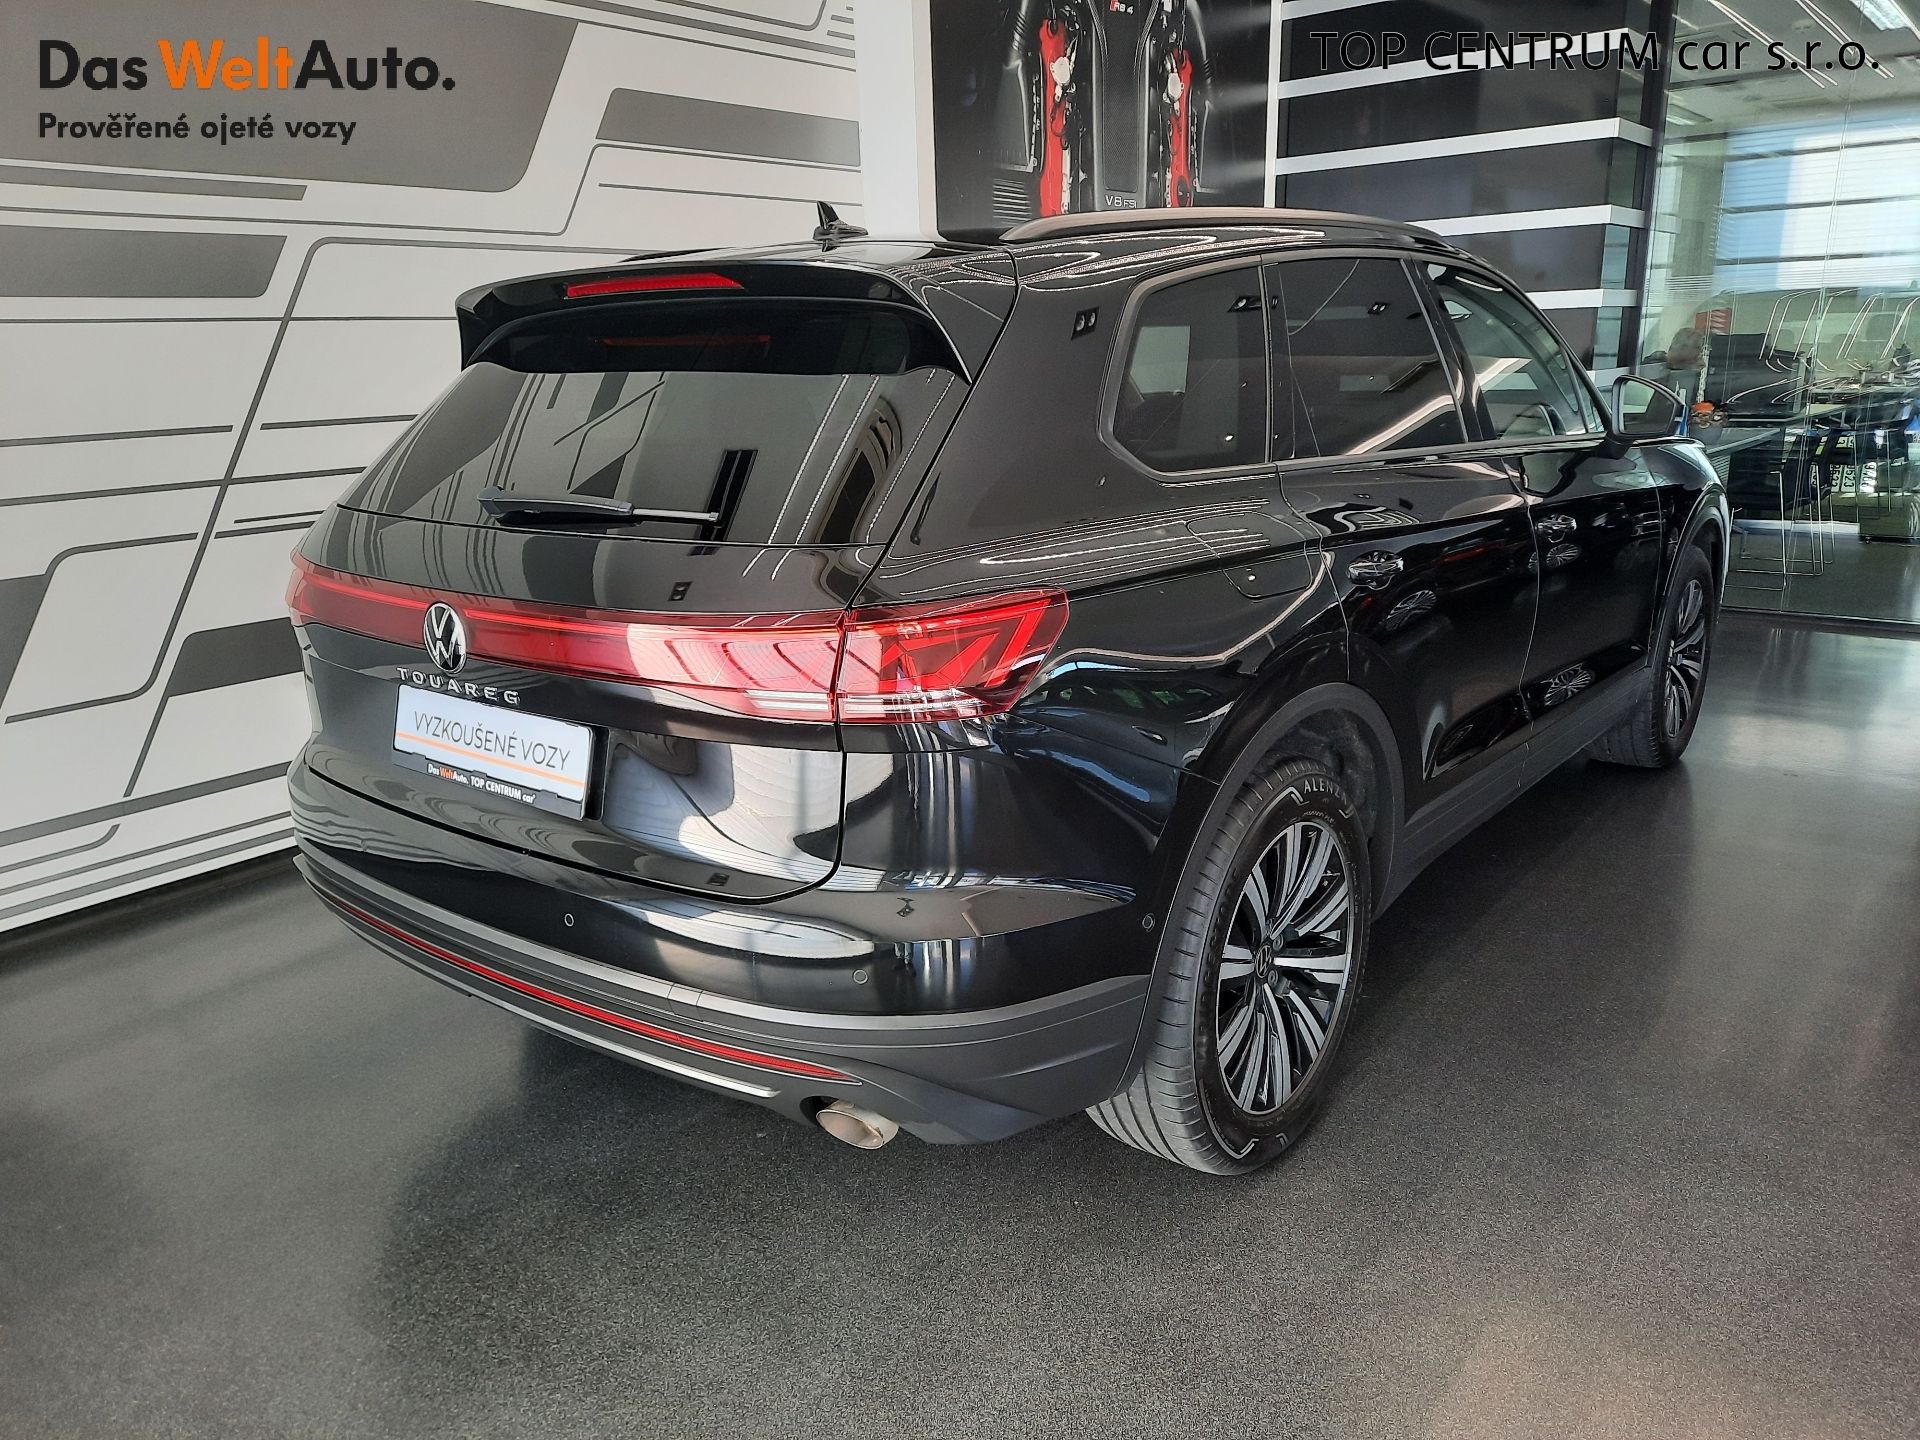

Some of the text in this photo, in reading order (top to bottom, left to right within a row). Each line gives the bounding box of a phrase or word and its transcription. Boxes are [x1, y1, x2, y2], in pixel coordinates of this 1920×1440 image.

[397, 667, 521, 706] TOUAREG
[414, 711, 571, 771] VYZKOUŠENÉ VOZY
[427, 763, 440, 776] Das
[470, 776, 486, 789] TOP
[485, 780, 522, 801] CENTRUM
[1304, 777, 1347, 805] ALENZA
